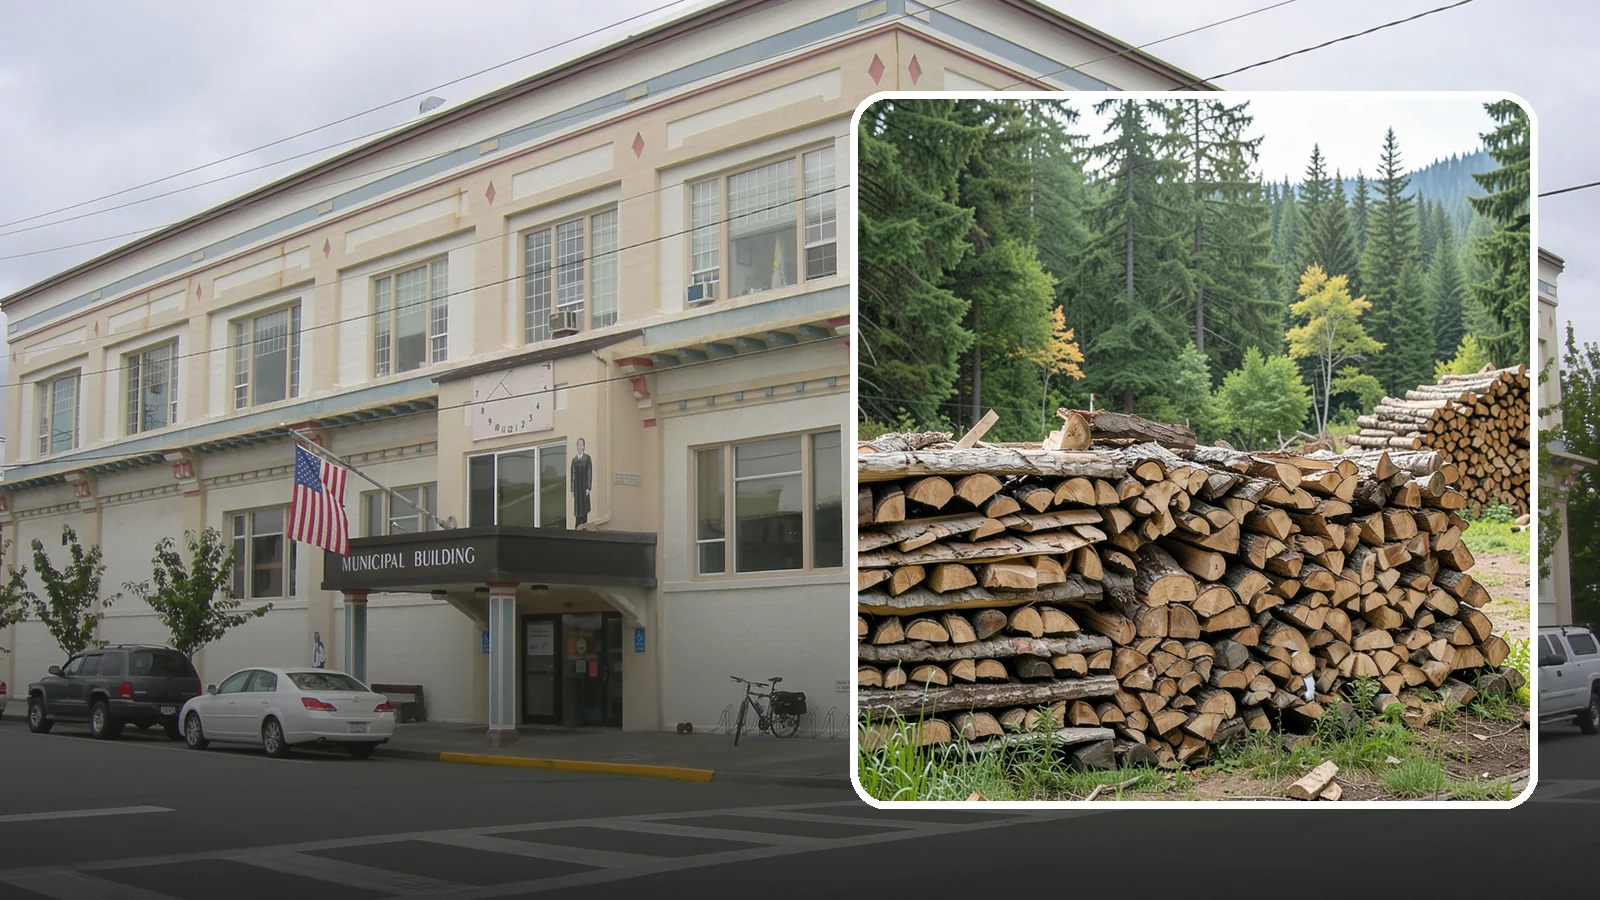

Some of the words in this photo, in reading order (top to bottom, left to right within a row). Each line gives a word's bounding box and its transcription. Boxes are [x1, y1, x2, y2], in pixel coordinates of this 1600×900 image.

[475, 390, 479, 398] 7
[480, 407, 485, 415] 8
[487, 417, 492, 426] 9
[494, 424, 500, 432] 10
[501, 425, 506, 433] 11
[507, 425, 513, 433] 12
[521, 420, 525, 428] 2
[529, 414, 533, 422] 3
[536, 402, 540, 410] 4
[543, 385, 548, 393] 5
[342, 552, 405, 572] MUNICIPAL
[414, 546, 475, 567] BUILDING
